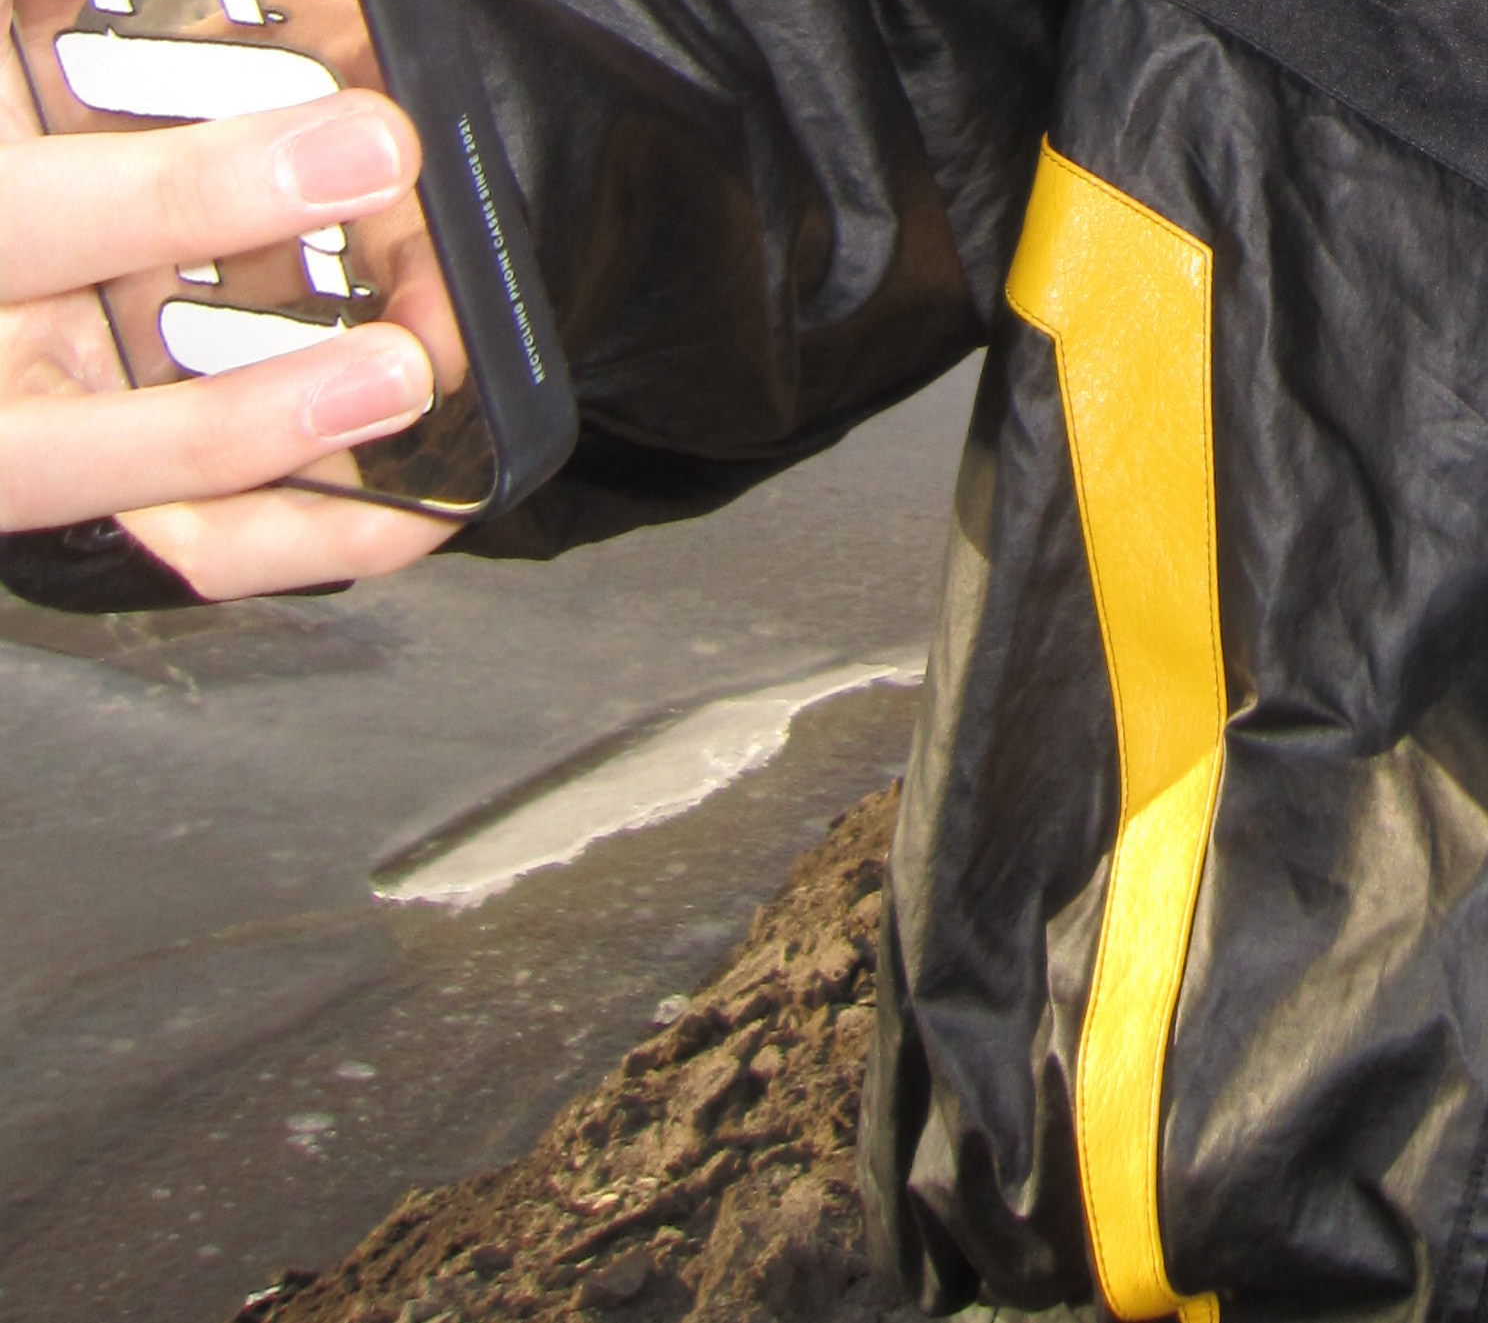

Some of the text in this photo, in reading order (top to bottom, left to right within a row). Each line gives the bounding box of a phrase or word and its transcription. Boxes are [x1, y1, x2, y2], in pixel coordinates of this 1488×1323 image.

[468, 153, 492, 200] SINCE
[482, 201, 504, 248] CASES
[497, 249, 521, 301] PHONE
[513, 303, 546, 385] RECYCLING
